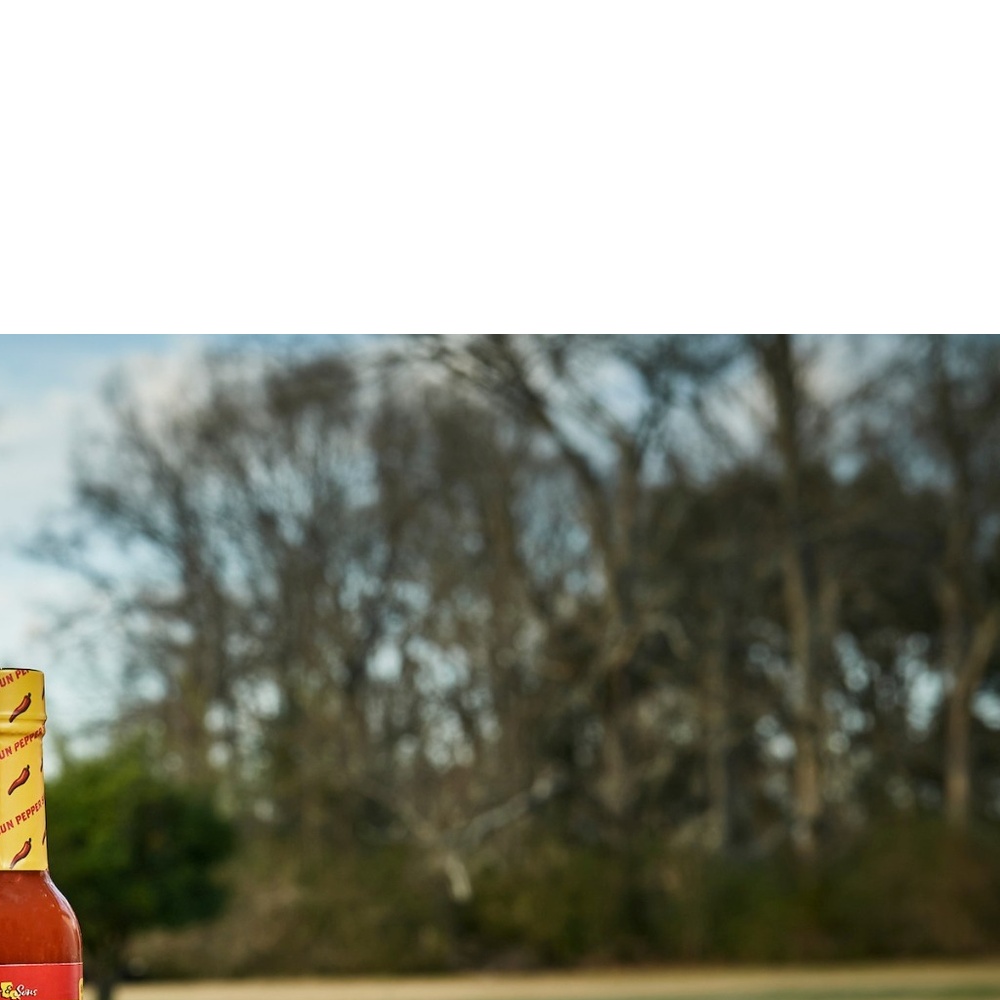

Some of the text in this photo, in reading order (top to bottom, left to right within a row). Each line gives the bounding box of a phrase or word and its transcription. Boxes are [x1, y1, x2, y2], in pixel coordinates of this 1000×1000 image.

[14, 669, 29, 679] PE
[14, 727, 43, 752] PEPPER
[16, 984, 38, 997] Sons
